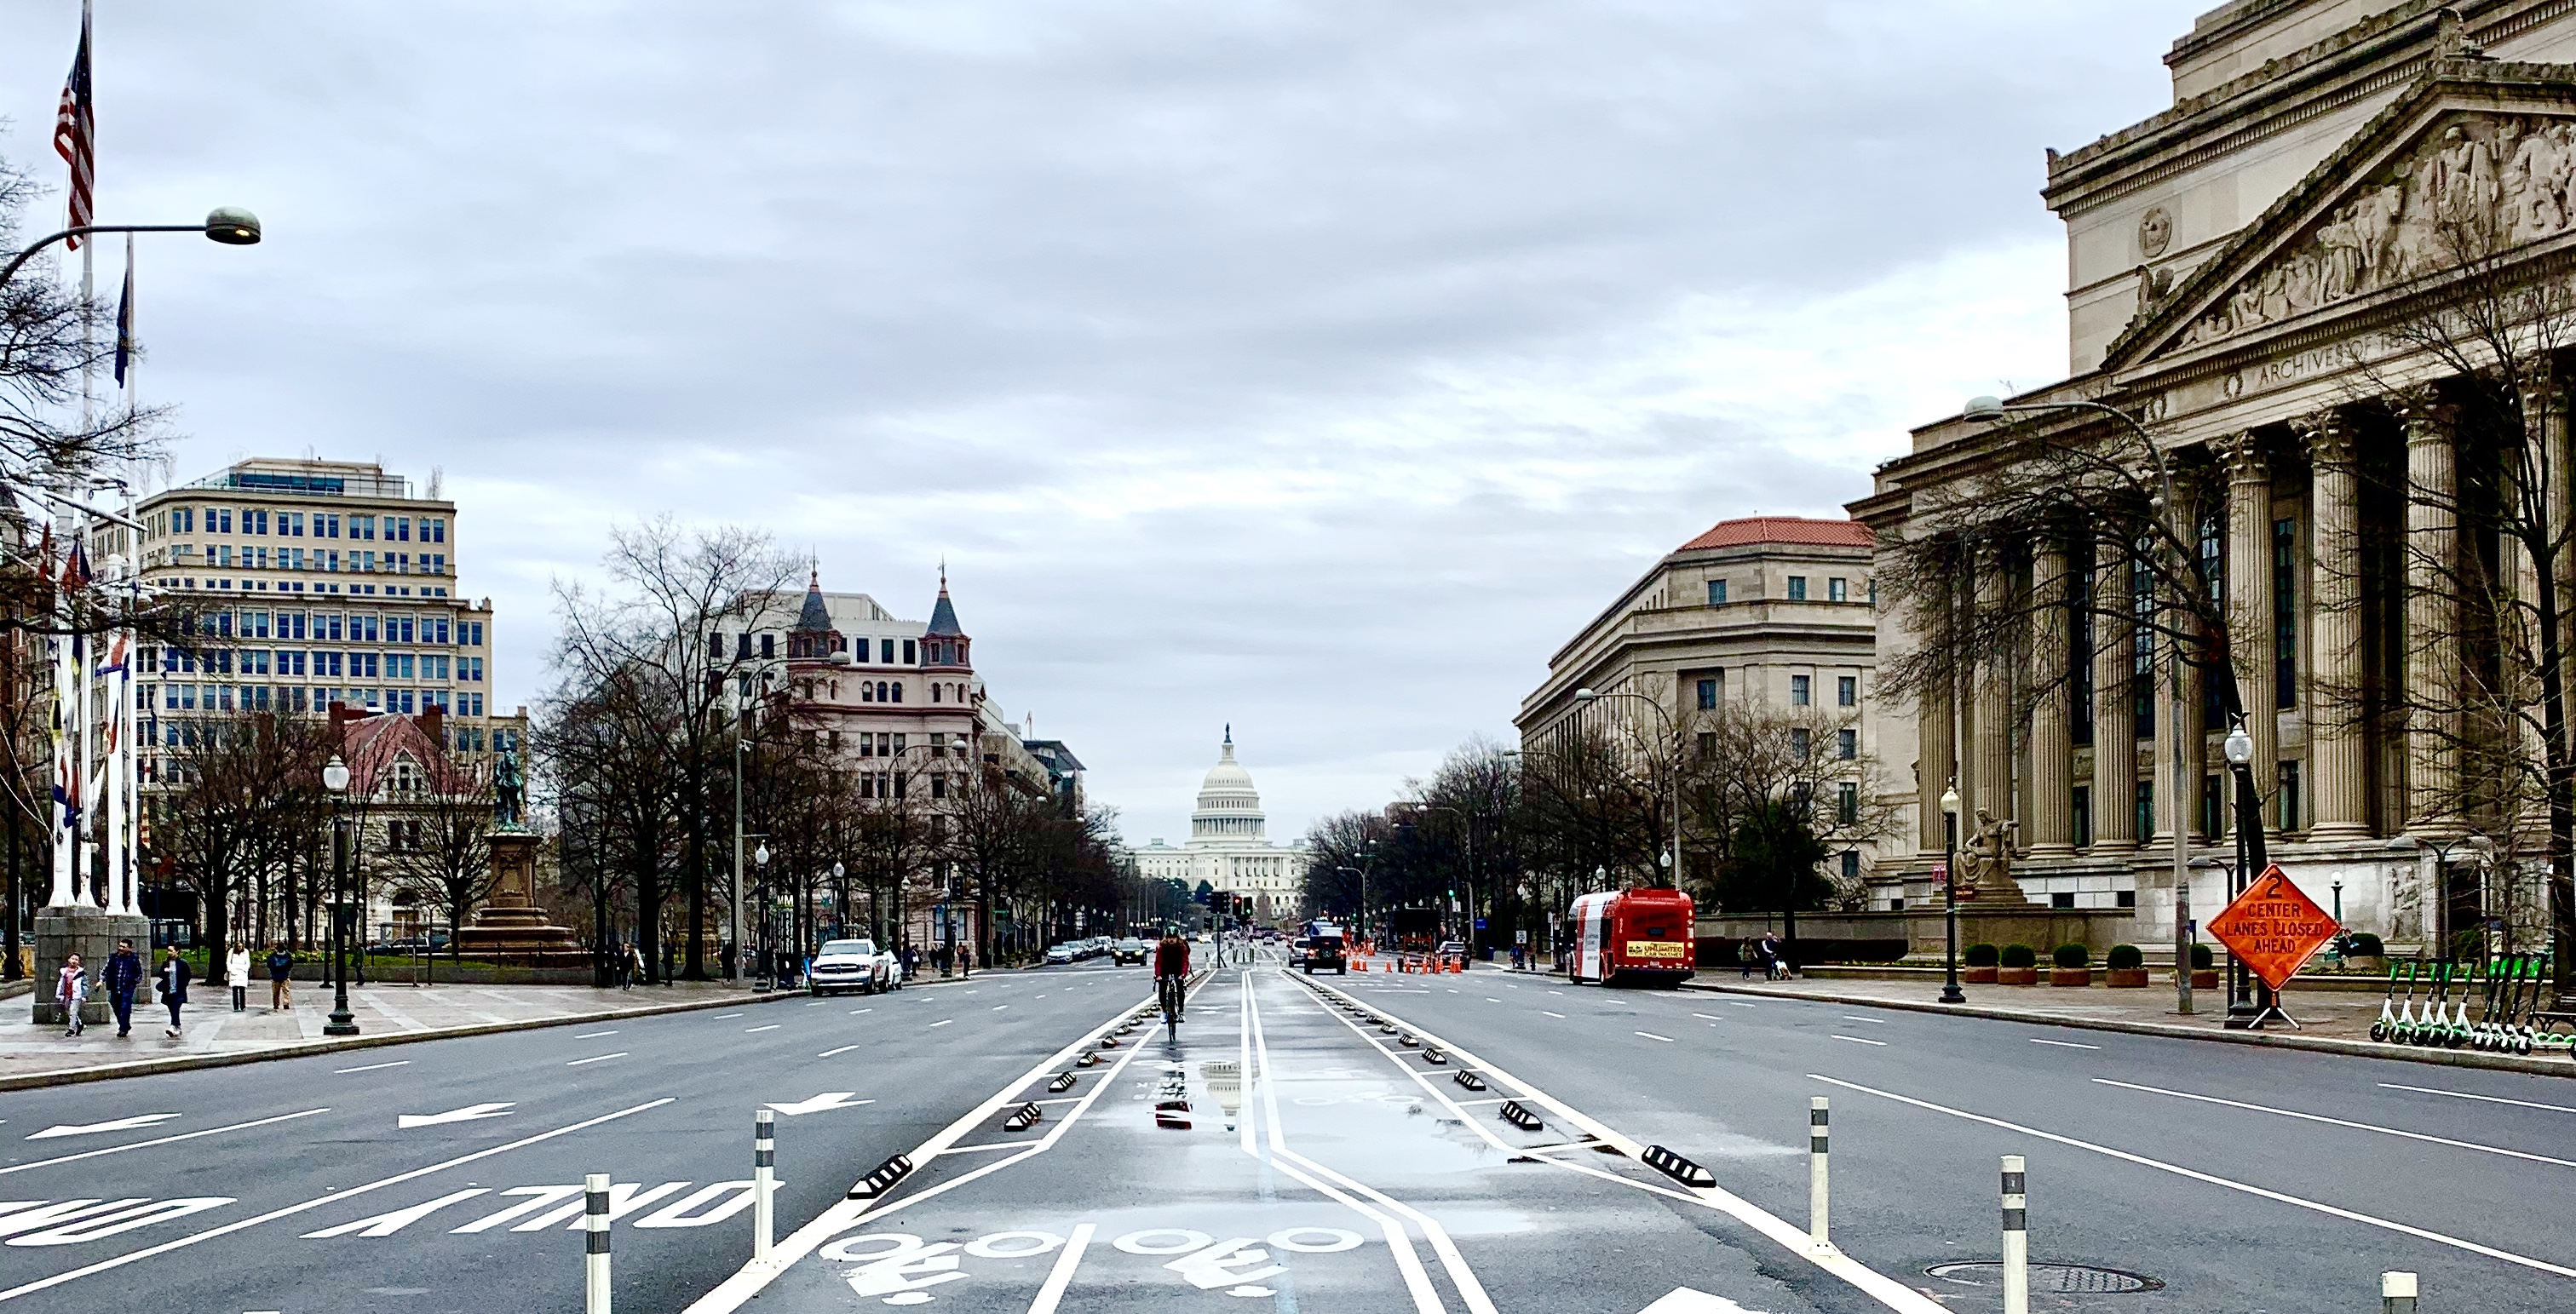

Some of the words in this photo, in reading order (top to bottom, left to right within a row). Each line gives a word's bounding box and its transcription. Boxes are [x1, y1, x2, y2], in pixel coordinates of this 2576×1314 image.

[2259, 343, 2343, 385] ARCHIVES
[2349, 336, 2372, 358] OF
[2266, 874, 2283, 898] 2
[2247, 903, 2301, 917] CENTER
[2225, 922, 2268, 936] LANES
[2273, 921, 2324, 936] CLOSED
[2253, 938, 2296, 953] AHEAD
[298, 1180, 786, 1238] ONLY
